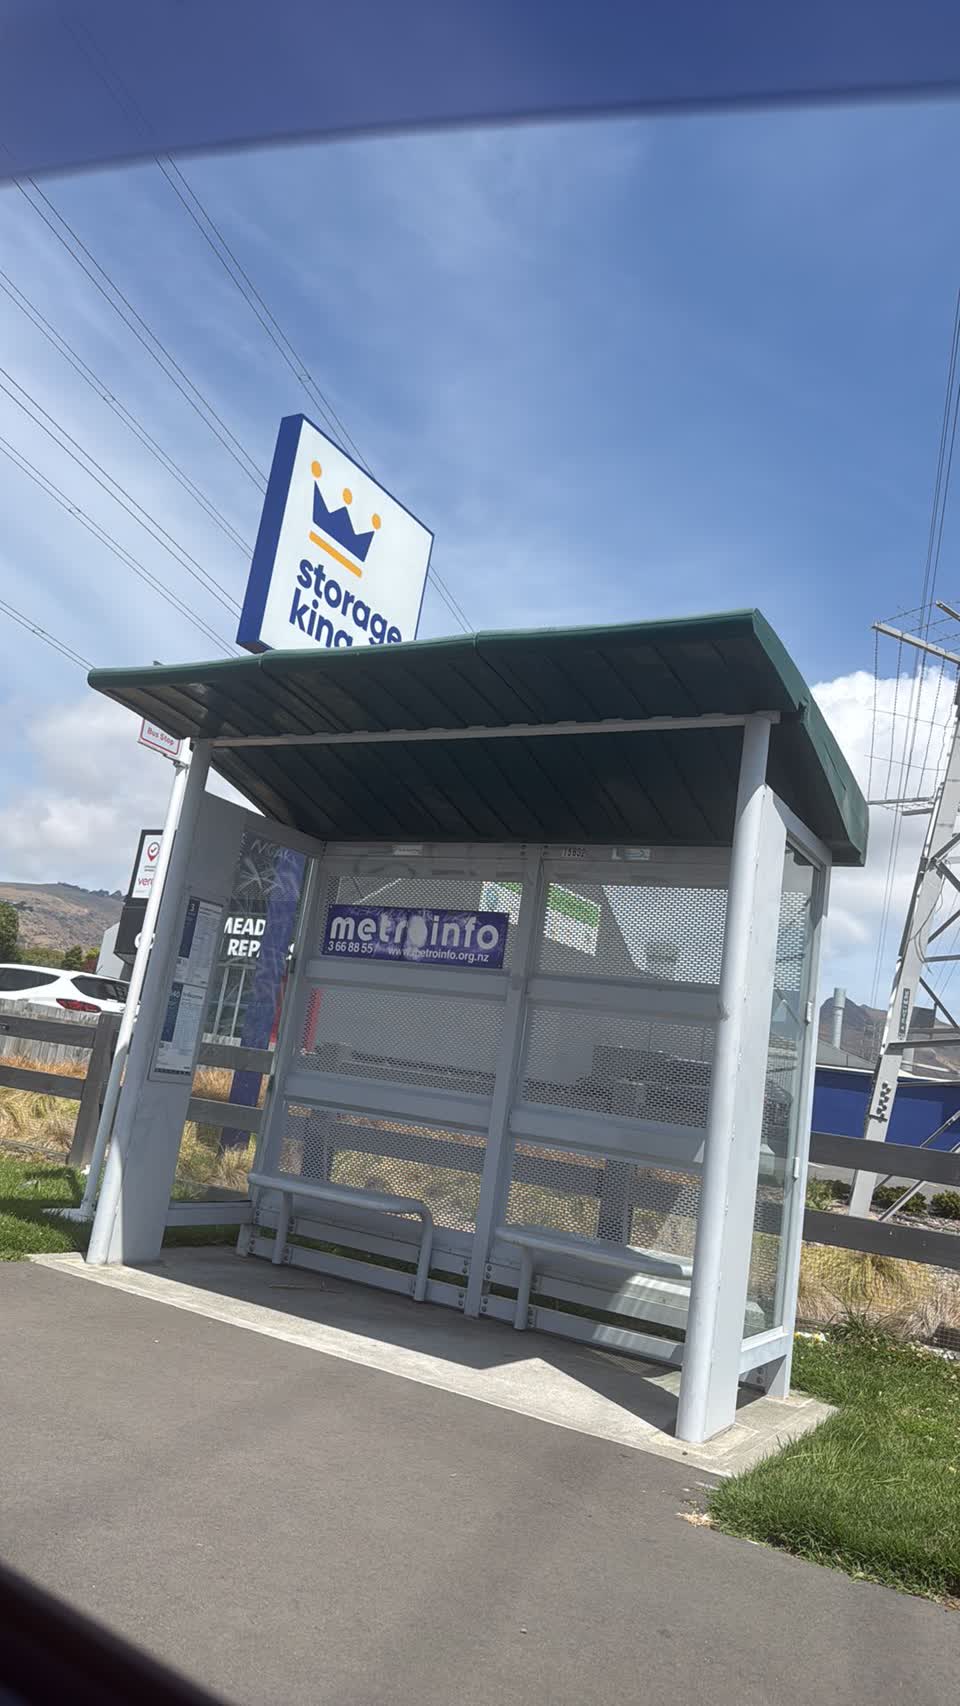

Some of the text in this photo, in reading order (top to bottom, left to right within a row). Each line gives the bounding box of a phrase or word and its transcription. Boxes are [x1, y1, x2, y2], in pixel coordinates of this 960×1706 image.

[297, 559, 402, 645] storage
[147, 727, 174, 746] Bus Stop
[330, 915, 499, 950] metroinfo
